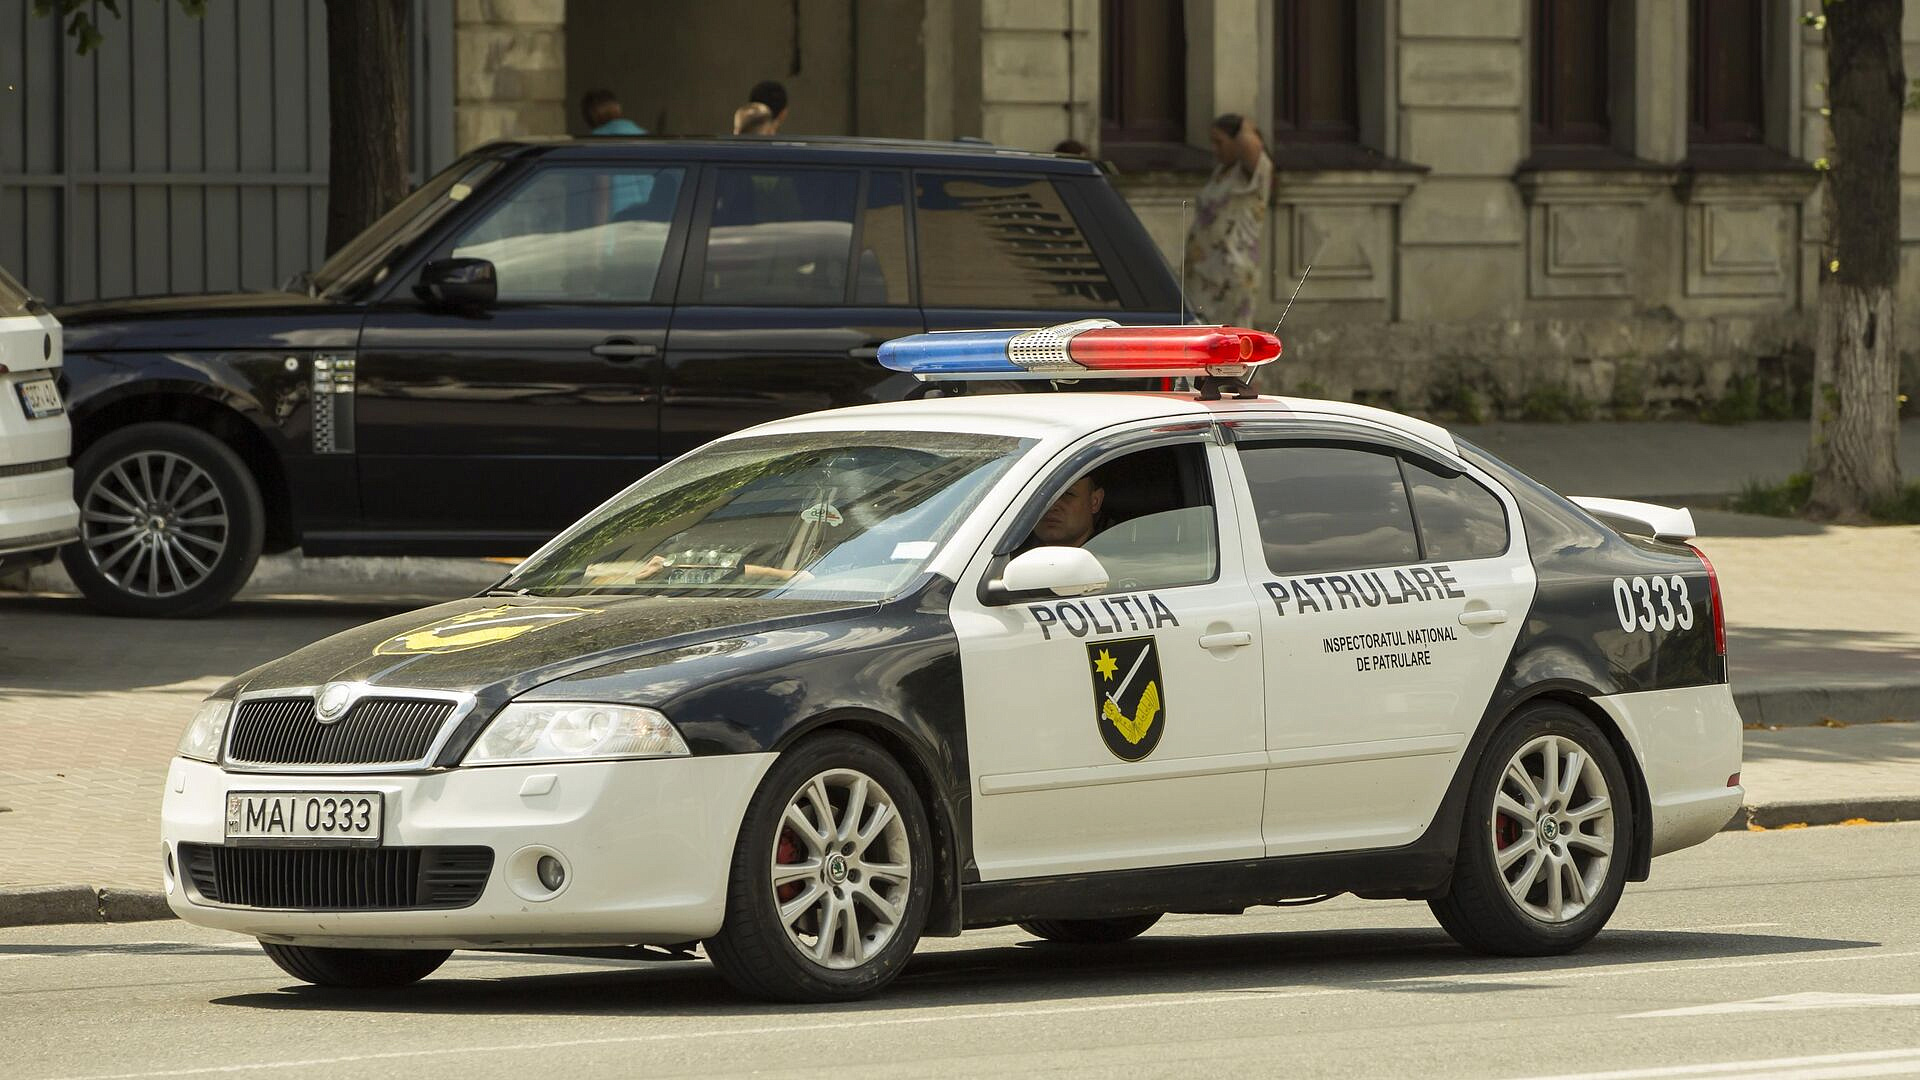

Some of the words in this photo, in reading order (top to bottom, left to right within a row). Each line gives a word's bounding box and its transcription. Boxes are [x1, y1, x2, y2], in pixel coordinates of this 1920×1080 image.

[1028, 593, 1180, 641] POLIȚIA
[1263, 565, 1466, 617] PATRULARE
[1613, 575, 1694, 633] 0333
[1323, 631, 1406, 653] INSPECTORATUL
[1407, 626, 1458, 648] NAȚIONAL
[1356, 656, 1371, 672] DE
[1373, 650, 1432, 670] PATRULARE
[246, 798, 296, 833] MAI
[305, 798, 372, 832] 0333
